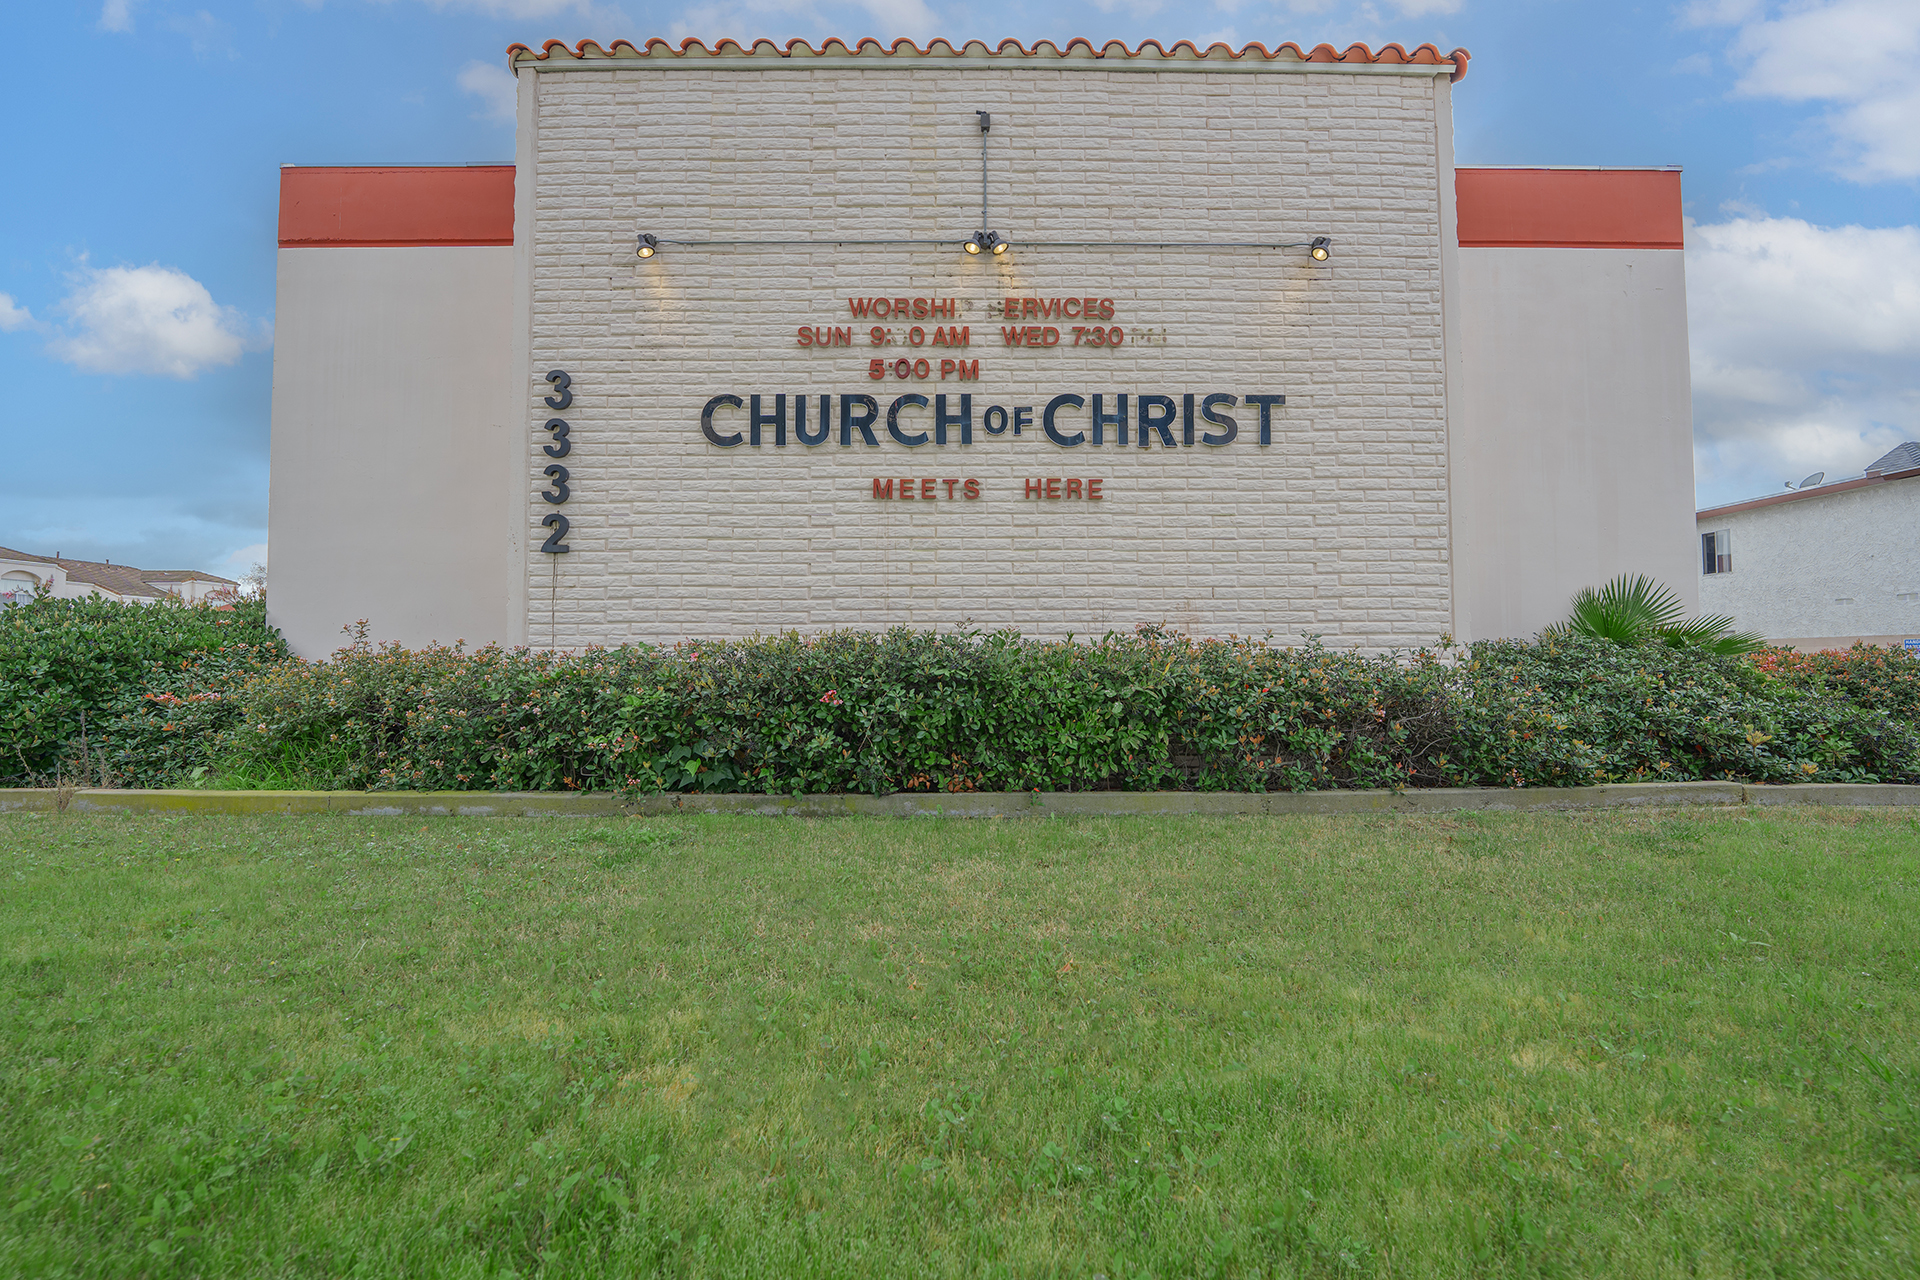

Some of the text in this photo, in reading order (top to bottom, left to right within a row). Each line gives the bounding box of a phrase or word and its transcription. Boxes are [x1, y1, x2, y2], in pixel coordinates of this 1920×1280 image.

[849, 297, 1116, 319] WORSHI ERVICES
[796, 325, 852, 347] SUN
[870, 325, 927, 347] 9:0
[931, 325, 970, 346] AM
[1001, 325, 1060, 346] WED
[1072, 325, 1124, 347] 7:30
[868, 358, 980, 381] 5:00 PM
[700, 393, 1286, 448] CHURCH OF CHRIST
[540, 369, 574, 554] 3332
[873, 478, 1104, 500] MEETS HERE
